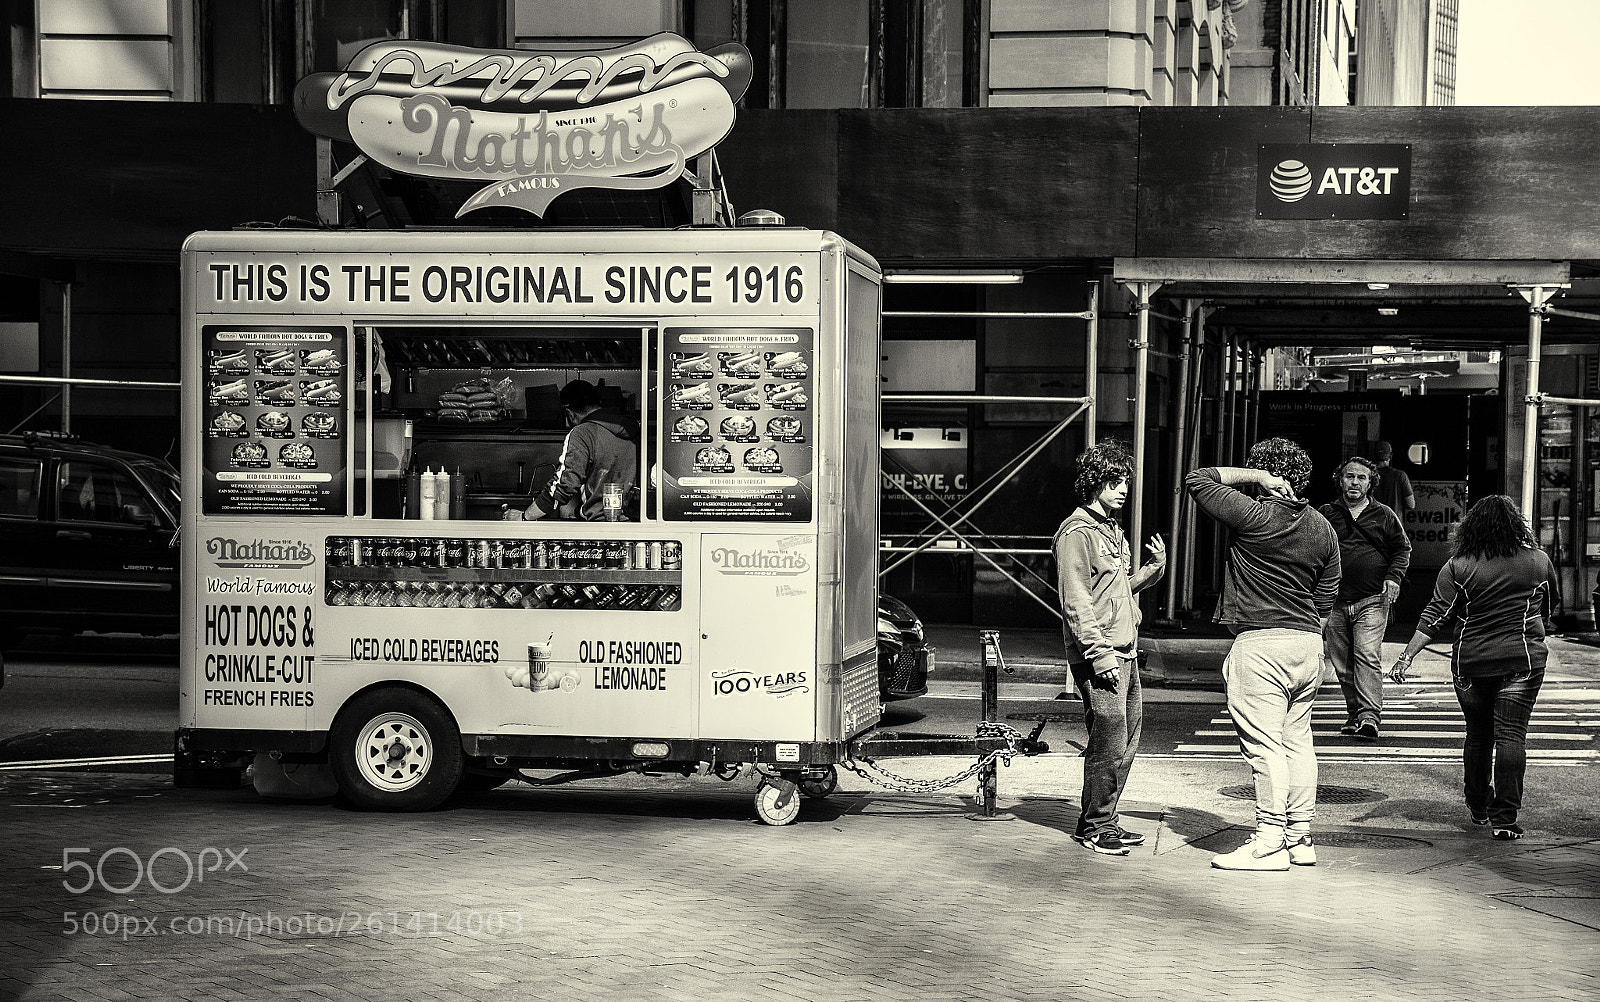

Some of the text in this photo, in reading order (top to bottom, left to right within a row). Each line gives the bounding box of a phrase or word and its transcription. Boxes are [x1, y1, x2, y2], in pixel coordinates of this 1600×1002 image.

[400, 92, 677, 175] Nathan's
[555, 118, 578, 127] SINCE
[498, 177, 560, 197] FAMOUS
[1317, 167, 1399, 196] AT&T
[210, 265, 804, 303] THIS IS THE ORIGINAL SINCE 1916
[1269, 403, 1292, 411] Work
[1293, 403, 1302, 411] in
[1304, 403, 1341, 412] Progress
[1350, 403, 1379, 411] HOTEL
[954, 474, 968, 490] C
[206, 537, 314, 561] Nathan's
[711, 548, 808, 569] Nathan's
[207, 577, 316, 595] World Famous
[205, 605, 314, 648] HOT DOGS &
[350, 638, 500, 663] ICED COLD BEVERAGES
[579, 640, 682, 665] OLD FASHIONED
[205, 654, 315, 684] CRINKLE-CUT
[594, 667, 667, 691] LEMONADE
[714, 672, 807, 696] 100 YEARS
[204, 690, 315, 707] FRENCH FRIES
